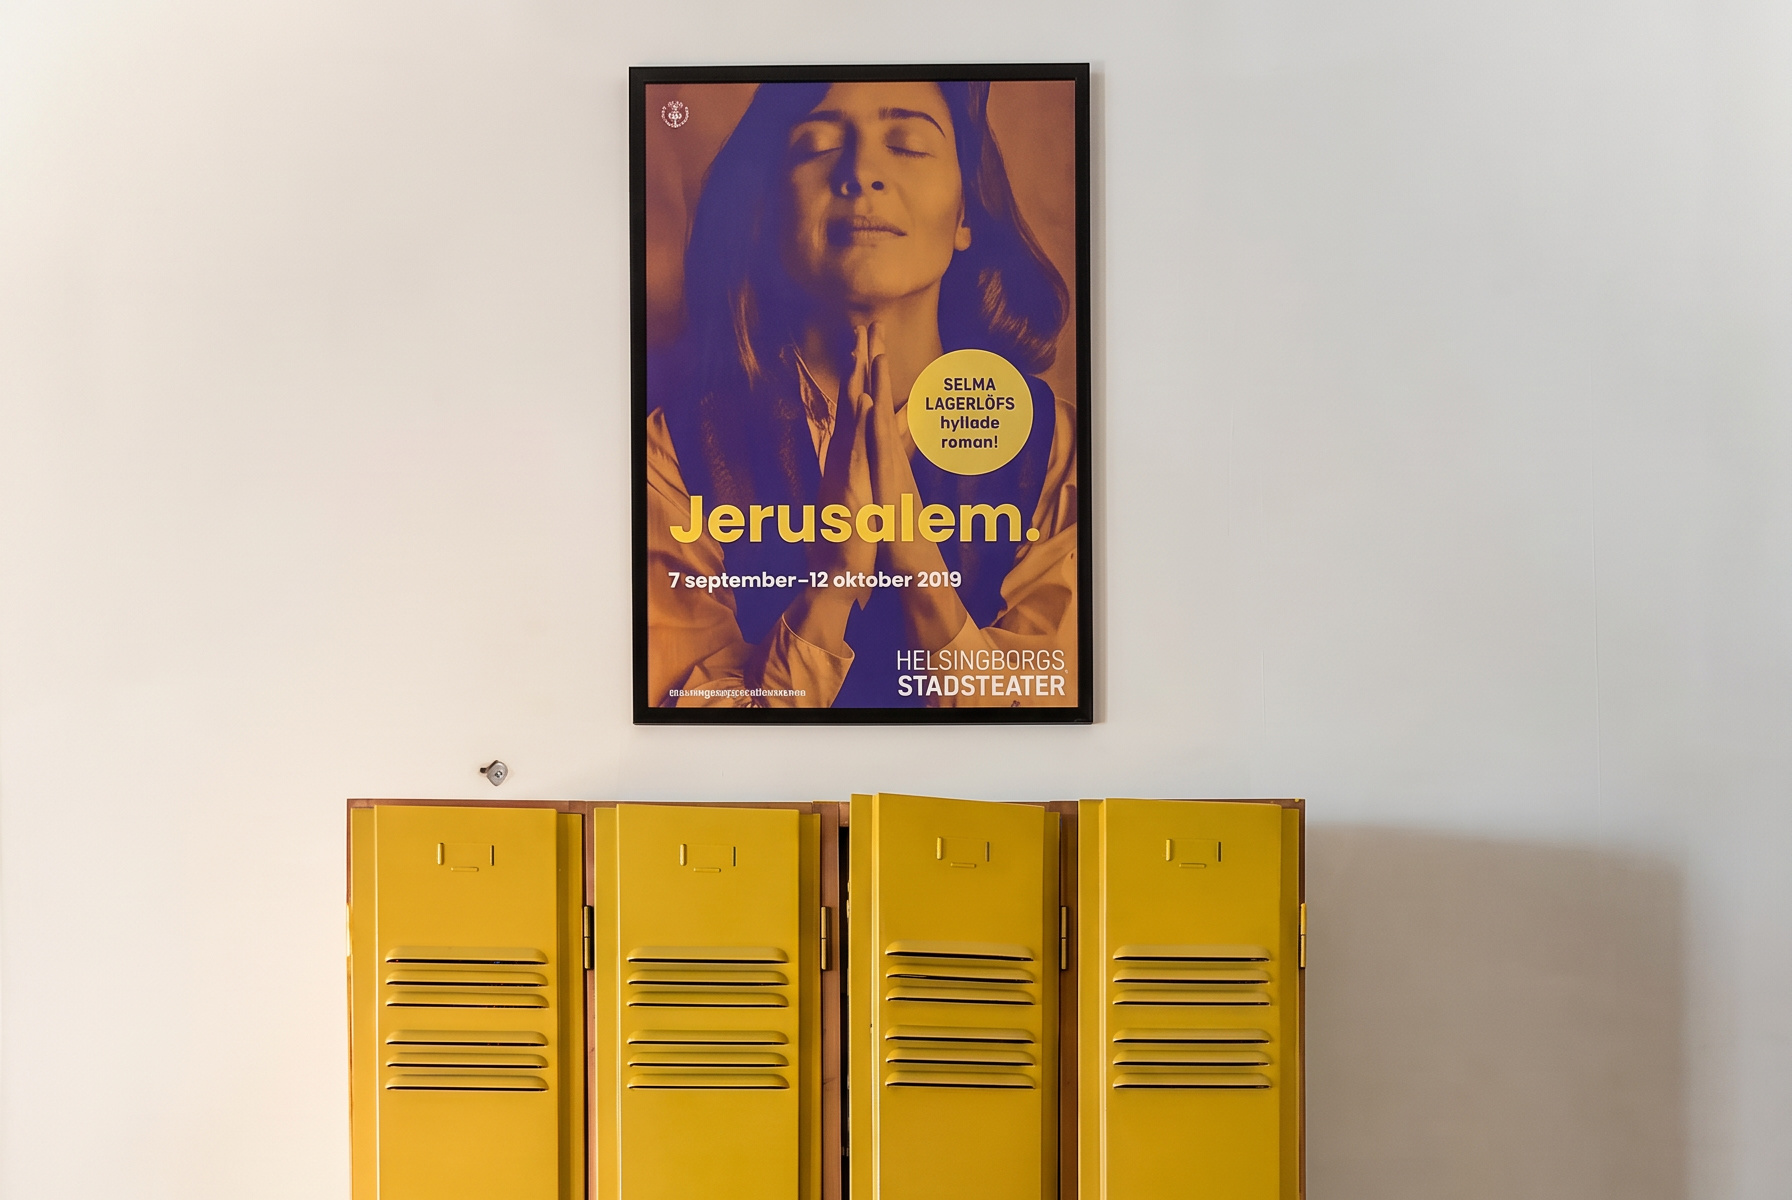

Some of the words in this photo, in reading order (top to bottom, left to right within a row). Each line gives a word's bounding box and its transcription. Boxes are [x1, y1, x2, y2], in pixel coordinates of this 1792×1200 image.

[943, 377, 997, 392] SELMA
[925, 394, 1016, 411] LAGERLÖFS
[940, 415, 1000, 432] hyllade
[941, 435, 998, 449] roman!
[669, 493, 1041, 543] Jerusalem.
[668, 572, 680, 588] 7
[832, 571, 912, 588] oktober
[916, 571, 962, 588] 2019
[896, 649, 1066, 671] HELSINGBORGS
[897, 674, 1066, 697] STADSTEATER
